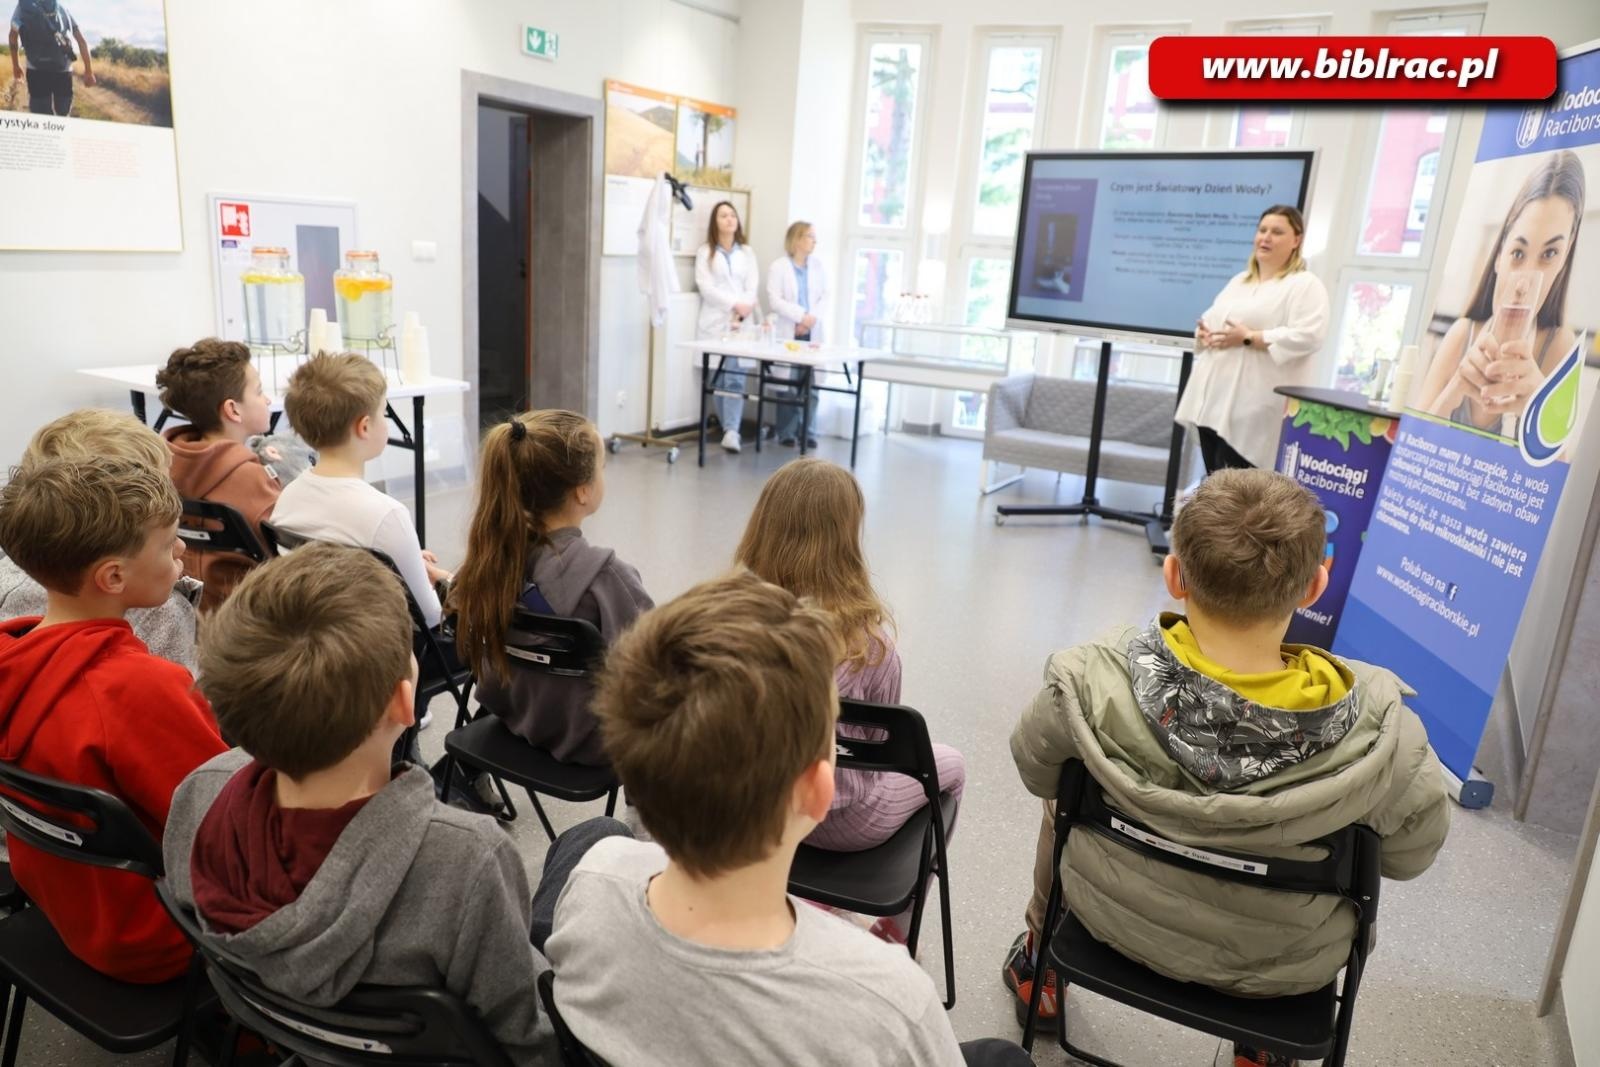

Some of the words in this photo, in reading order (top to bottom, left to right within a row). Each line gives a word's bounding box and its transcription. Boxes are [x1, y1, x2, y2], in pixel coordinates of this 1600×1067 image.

[43, 121, 65, 131] slow
[1110, 182, 1134, 195] Czym
[1135, 183, 1153, 195] jest
[1155, 181, 1201, 195] Światowy
[1204, 183, 1233, 194] Dzień
[1235, 184, 1273, 196] Wody?
[1297, 468, 1365, 499] Raciborskie
[1300, 453, 1369, 485] Wodociągi
[1462, 454, 1472, 466] to
[1473, 458, 1508, 482] szczęście,
[1511, 470, 1522, 484] że
[1524, 477, 1550, 495] woda
[1466, 484, 1480, 500] bez
[1481, 491, 1513, 514] żadnych
[1514, 506, 1540, 525] obaw
[1483, 475, 1528, 503] Raciborskie
[1525, 491, 1545, 510] jest
[1440, 513, 1463, 531] nasza
[1464, 525, 1489, 544] woda
[1490, 537, 1528, 562] zawiera
[1400, 556, 1422, 578] Polub
[1421, 570, 1436, 587] nas
[1434, 579, 1447, 593] na
[1491, 553, 1506, 569] nie
[1503, 558, 1524, 578] jest
